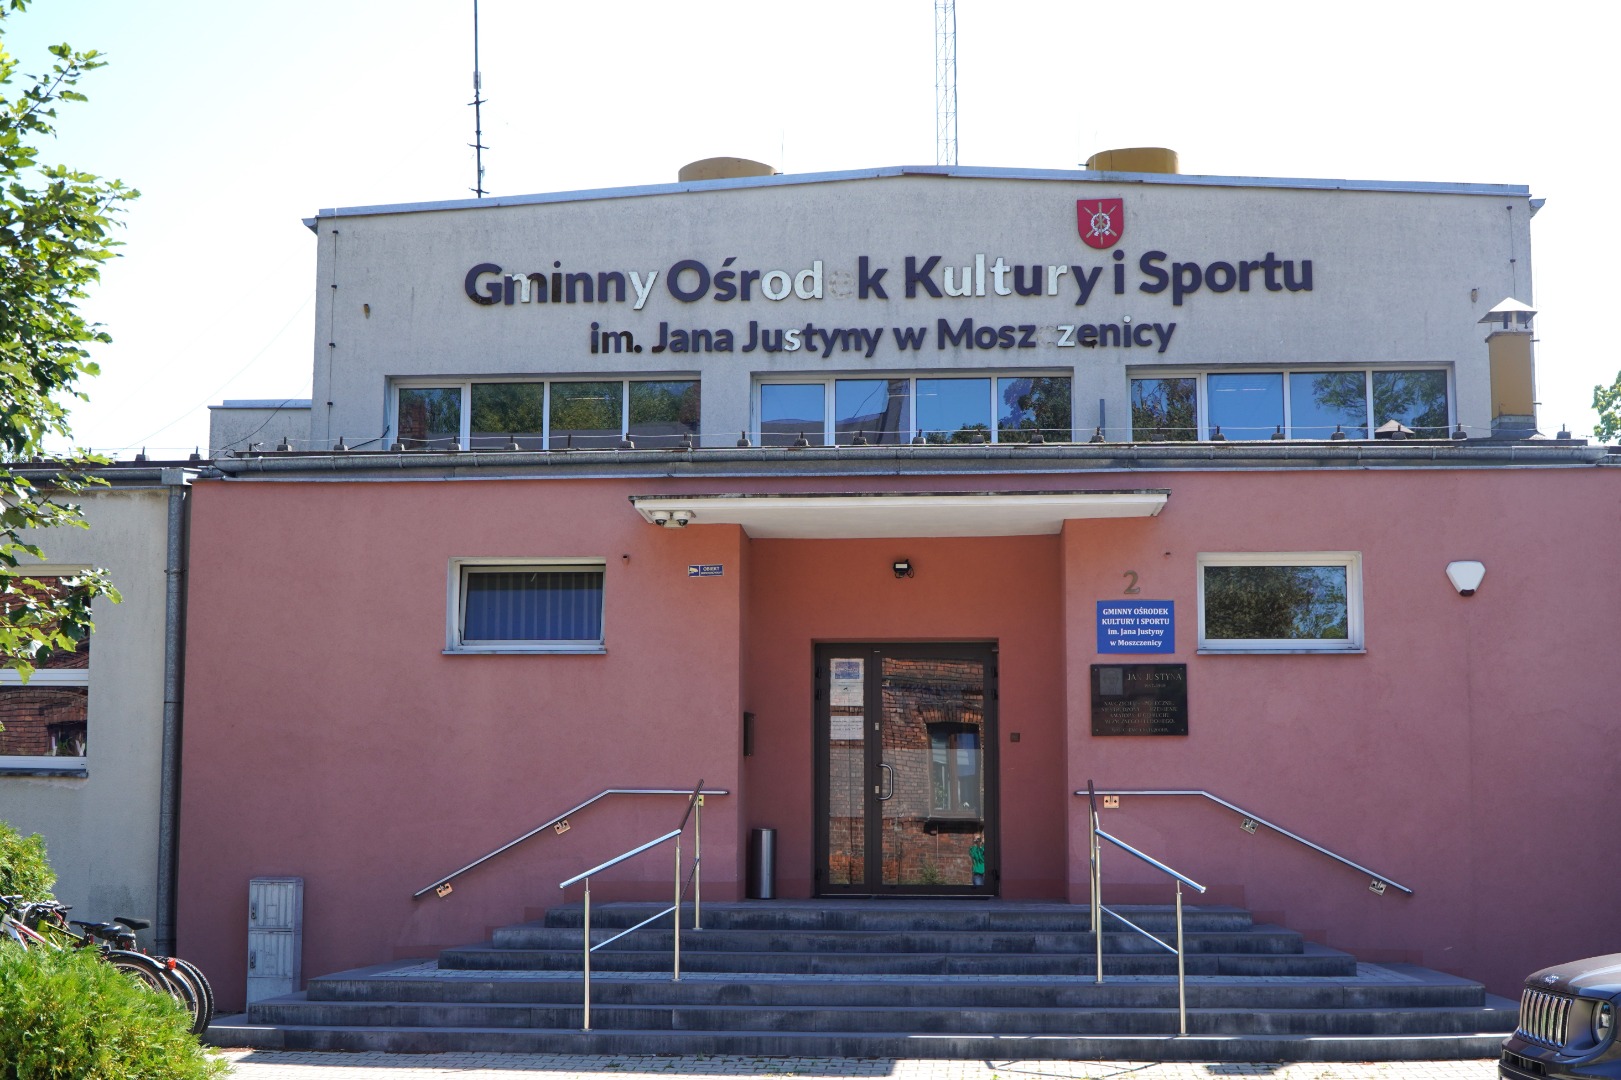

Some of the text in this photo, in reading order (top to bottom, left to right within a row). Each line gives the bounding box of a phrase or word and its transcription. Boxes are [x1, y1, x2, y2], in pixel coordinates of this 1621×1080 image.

[464, 249, 1314, 310] Gminny Ośrodk Kultury i Sportu
[590, 315, 1177, 358] im. Jana Justyny w Moszzenicy
[1123, 570, 1140, 594] 2
[1133, 606, 1169, 615] OŚRODEK
[1120, 628, 1136, 636] Jana
[1137, 628, 1164, 636] Justyny
